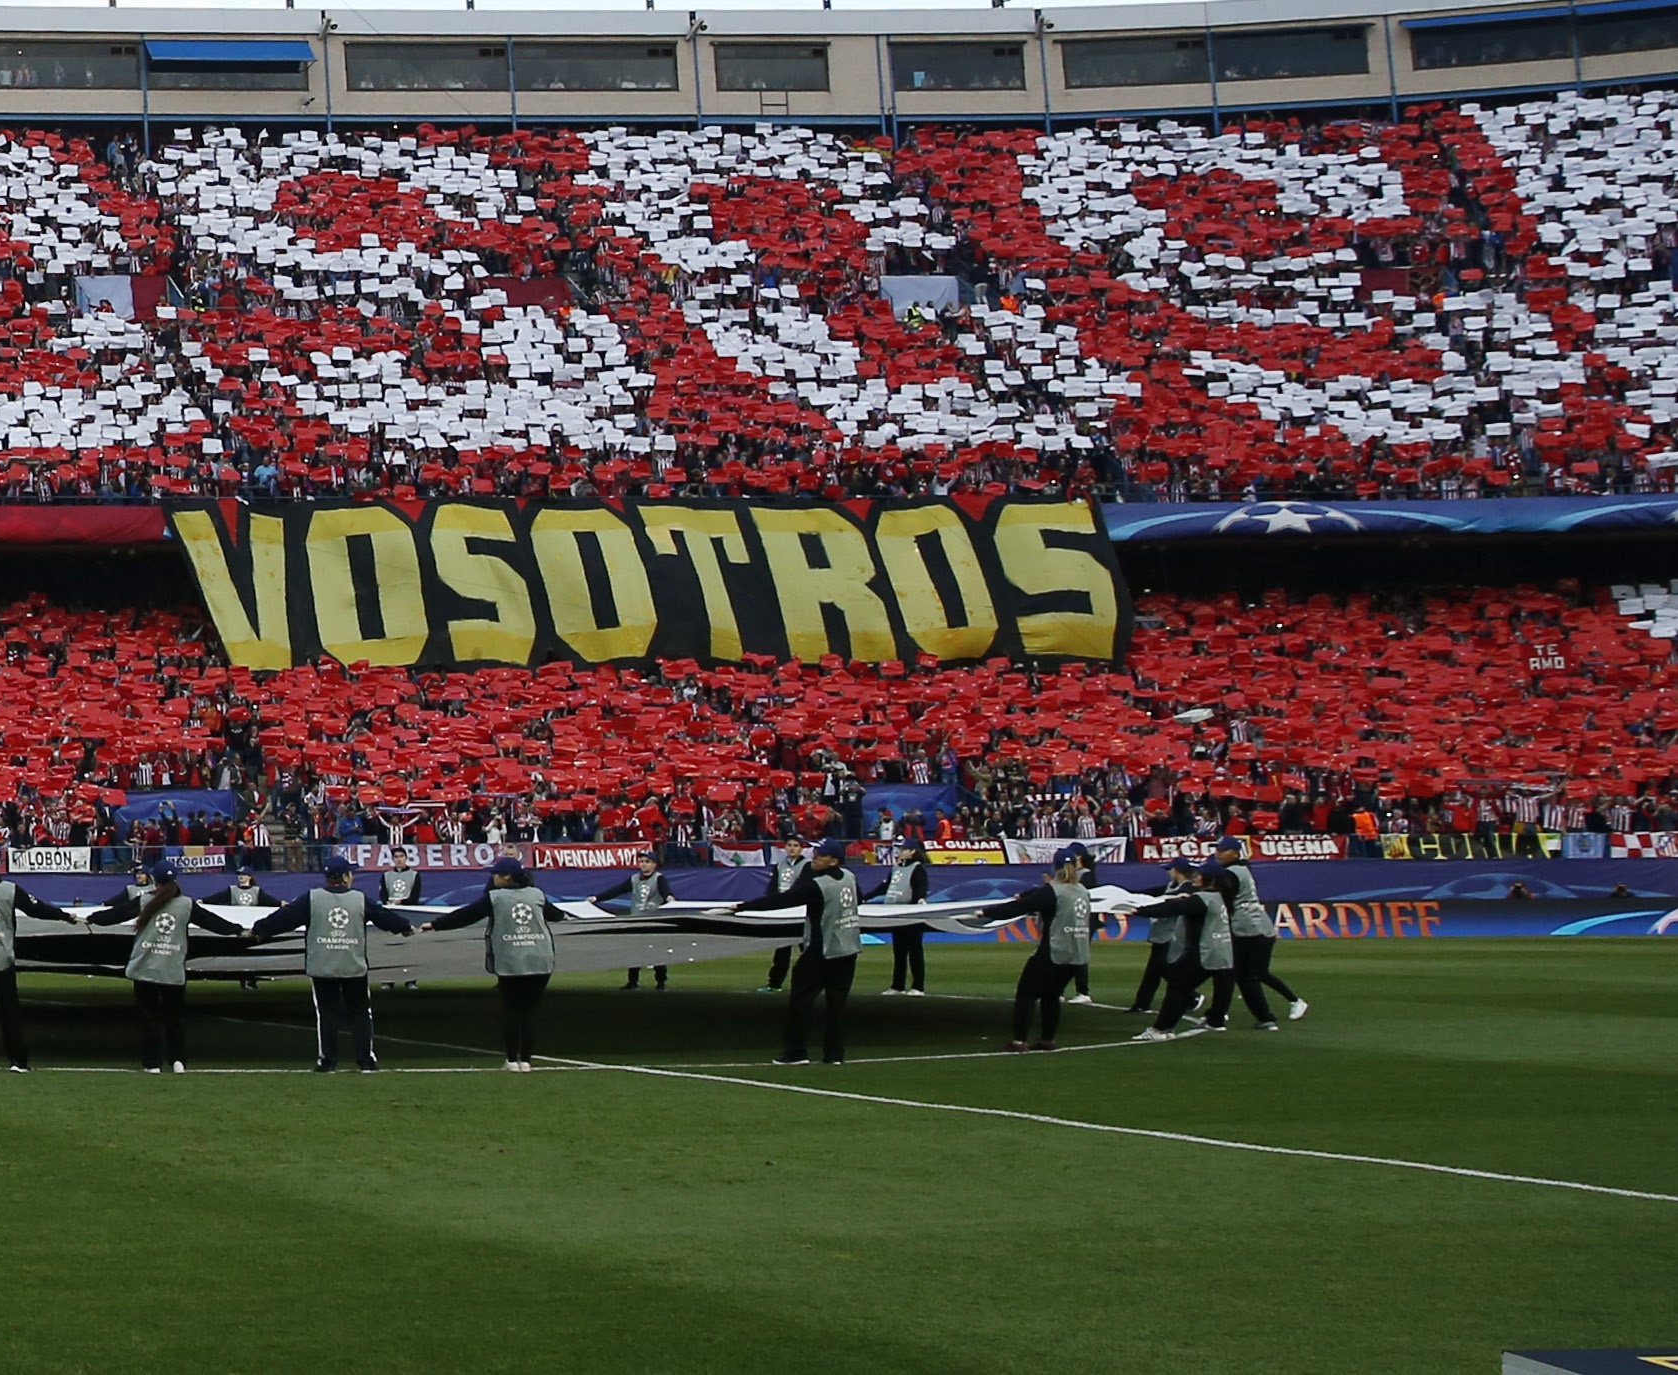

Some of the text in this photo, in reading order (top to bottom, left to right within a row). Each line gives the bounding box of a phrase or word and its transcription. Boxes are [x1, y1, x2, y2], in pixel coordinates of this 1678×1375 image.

[171, 500, 1119, 672] VOSOTROS
[1533, 643, 1559, 656] TE
[1528, 656, 1565, 670] AMO
[923, 840, 1001, 850] EL GUIJAR
[1259, 840, 1340, 856] UGENA
[356, 843, 495, 867] FABERO
[535, 849, 554, 868] LA
[554, 848, 616, 868] VENTANA
[1273, 902, 1441, 942] ARDIFF
